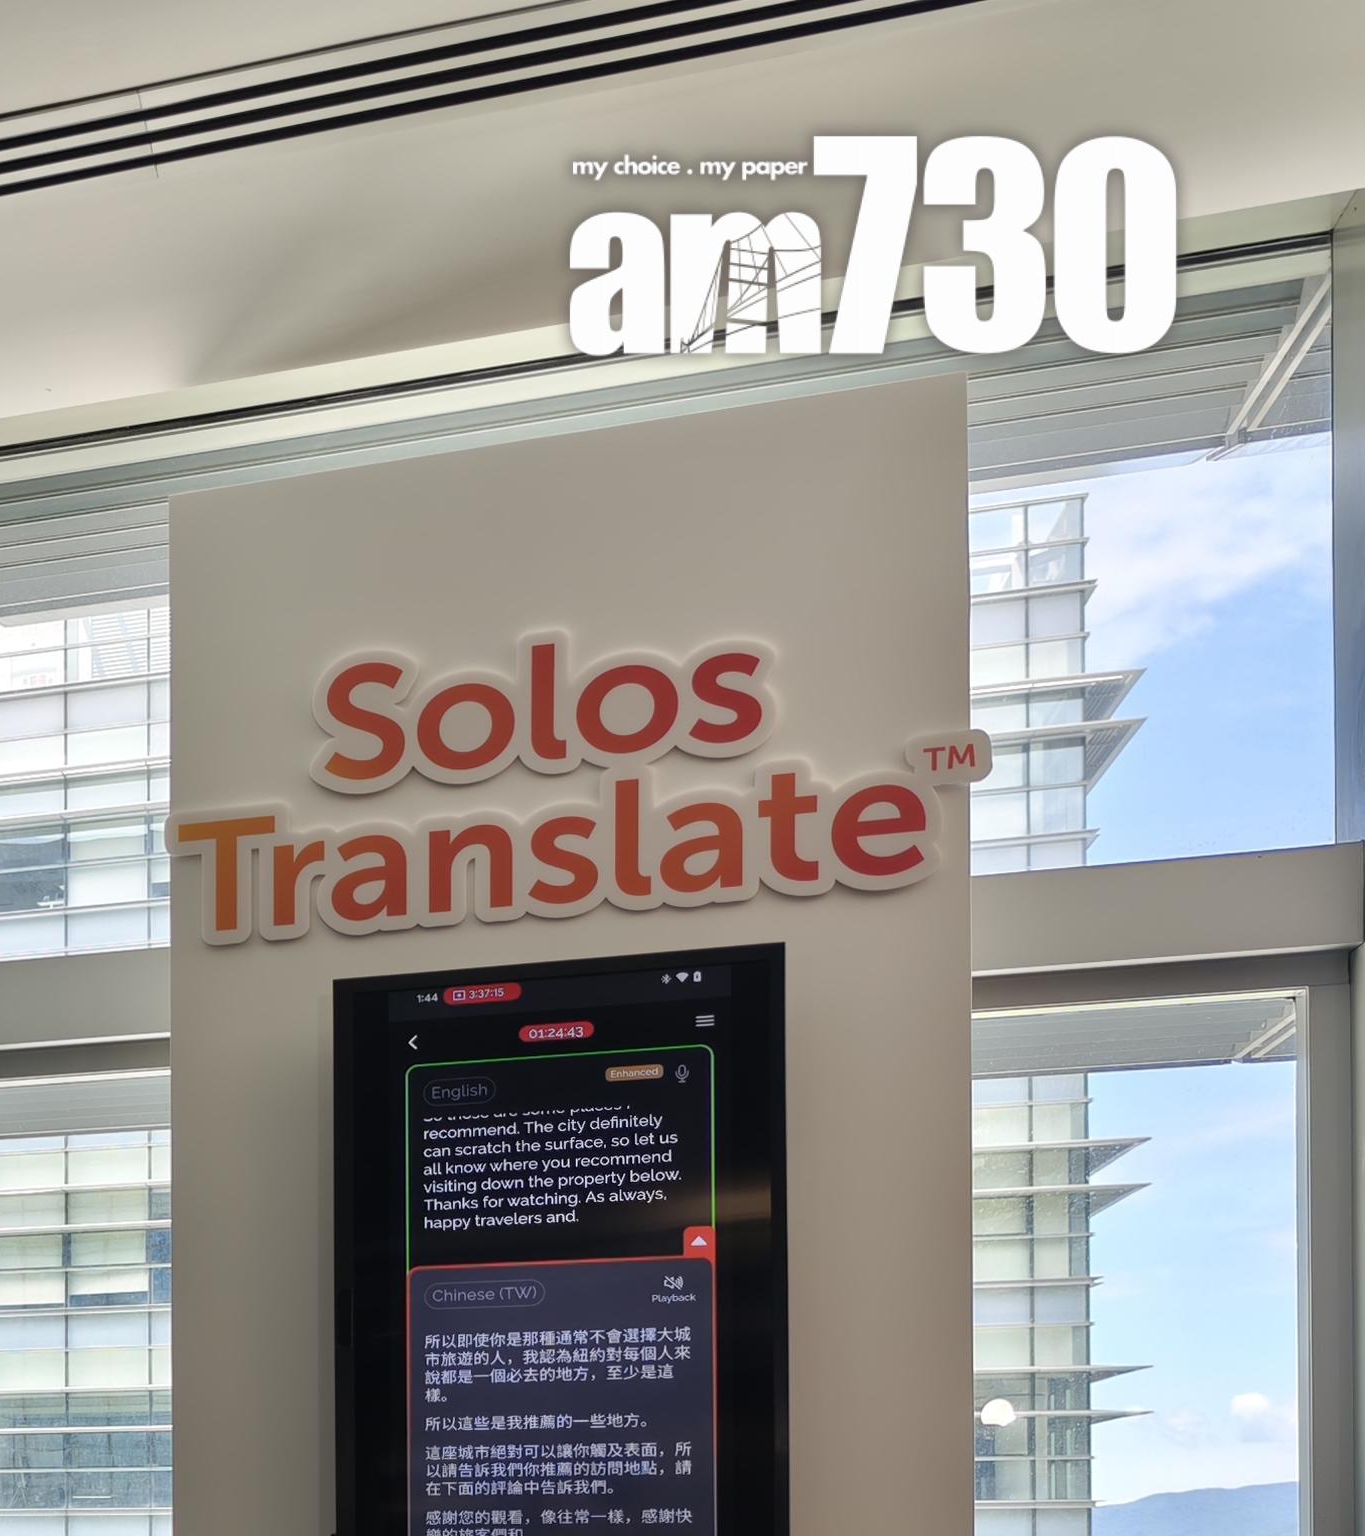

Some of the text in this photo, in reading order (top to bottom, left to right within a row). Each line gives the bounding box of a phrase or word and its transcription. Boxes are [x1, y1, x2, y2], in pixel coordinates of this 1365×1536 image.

[324, 643, 763, 780] Solos
[417, 987, 504, 1003] 1:44 3:37:15
[529, 1026, 584, 1039] 01:24:43
[431, 1066, 659, 1101] English Enhanced
[424, 1114, 662, 1139] recommend. The city definitely
[424, 1133, 678, 1157] can scratch the surface, so let us
[424, 1149, 672, 1175] all know where you recommend
[424, 1169, 681, 1194] visiting down the property below.
[424, 1189, 666, 1210] Thanks for watching. As always,
[424, 1210, 578, 1231] happy travelers and.
[432, 1286, 537, 1301] Chinese (TW)
[652, 1292, 697, 1304] Playback
[425, 1413, 648, 1431] 所以這些是我推薦的一些地方。
